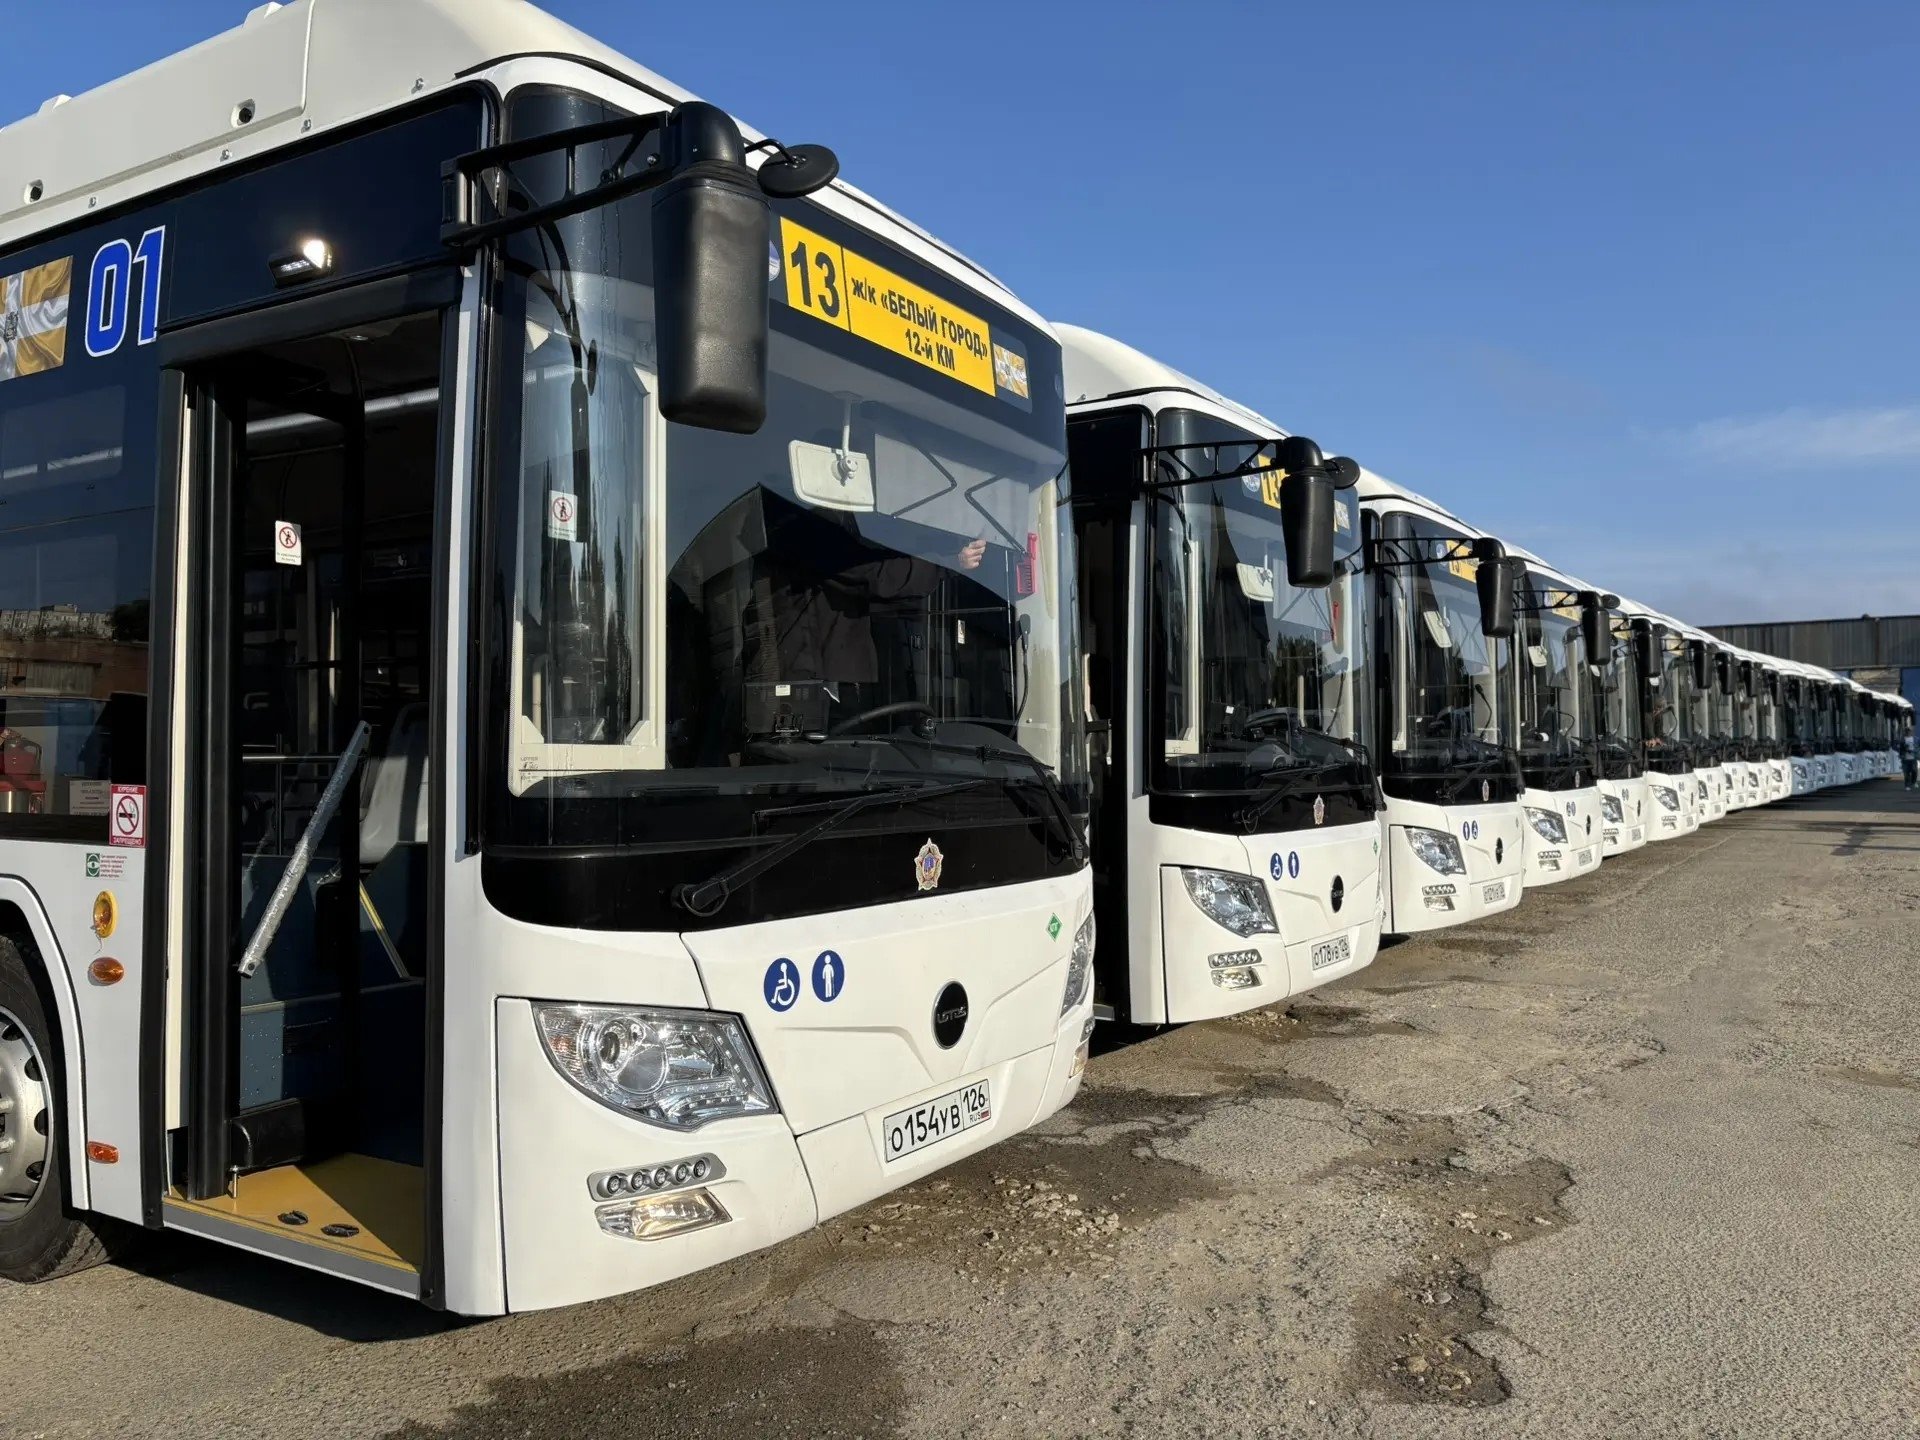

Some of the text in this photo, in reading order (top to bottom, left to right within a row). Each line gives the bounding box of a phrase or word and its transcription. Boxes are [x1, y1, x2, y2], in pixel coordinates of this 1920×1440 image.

[85, 225, 165, 357] 01
[791, 241, 840, 318] 13
[881, 289, 938, 334] «БЕЛЫЙ
[941, 315, 987, 360] ГОРОД»
[905, 328, 955, 371] 12-й КМ
[963, 1085, 986, 1113] 126
[970, 1111, 981, 1124] RUS
